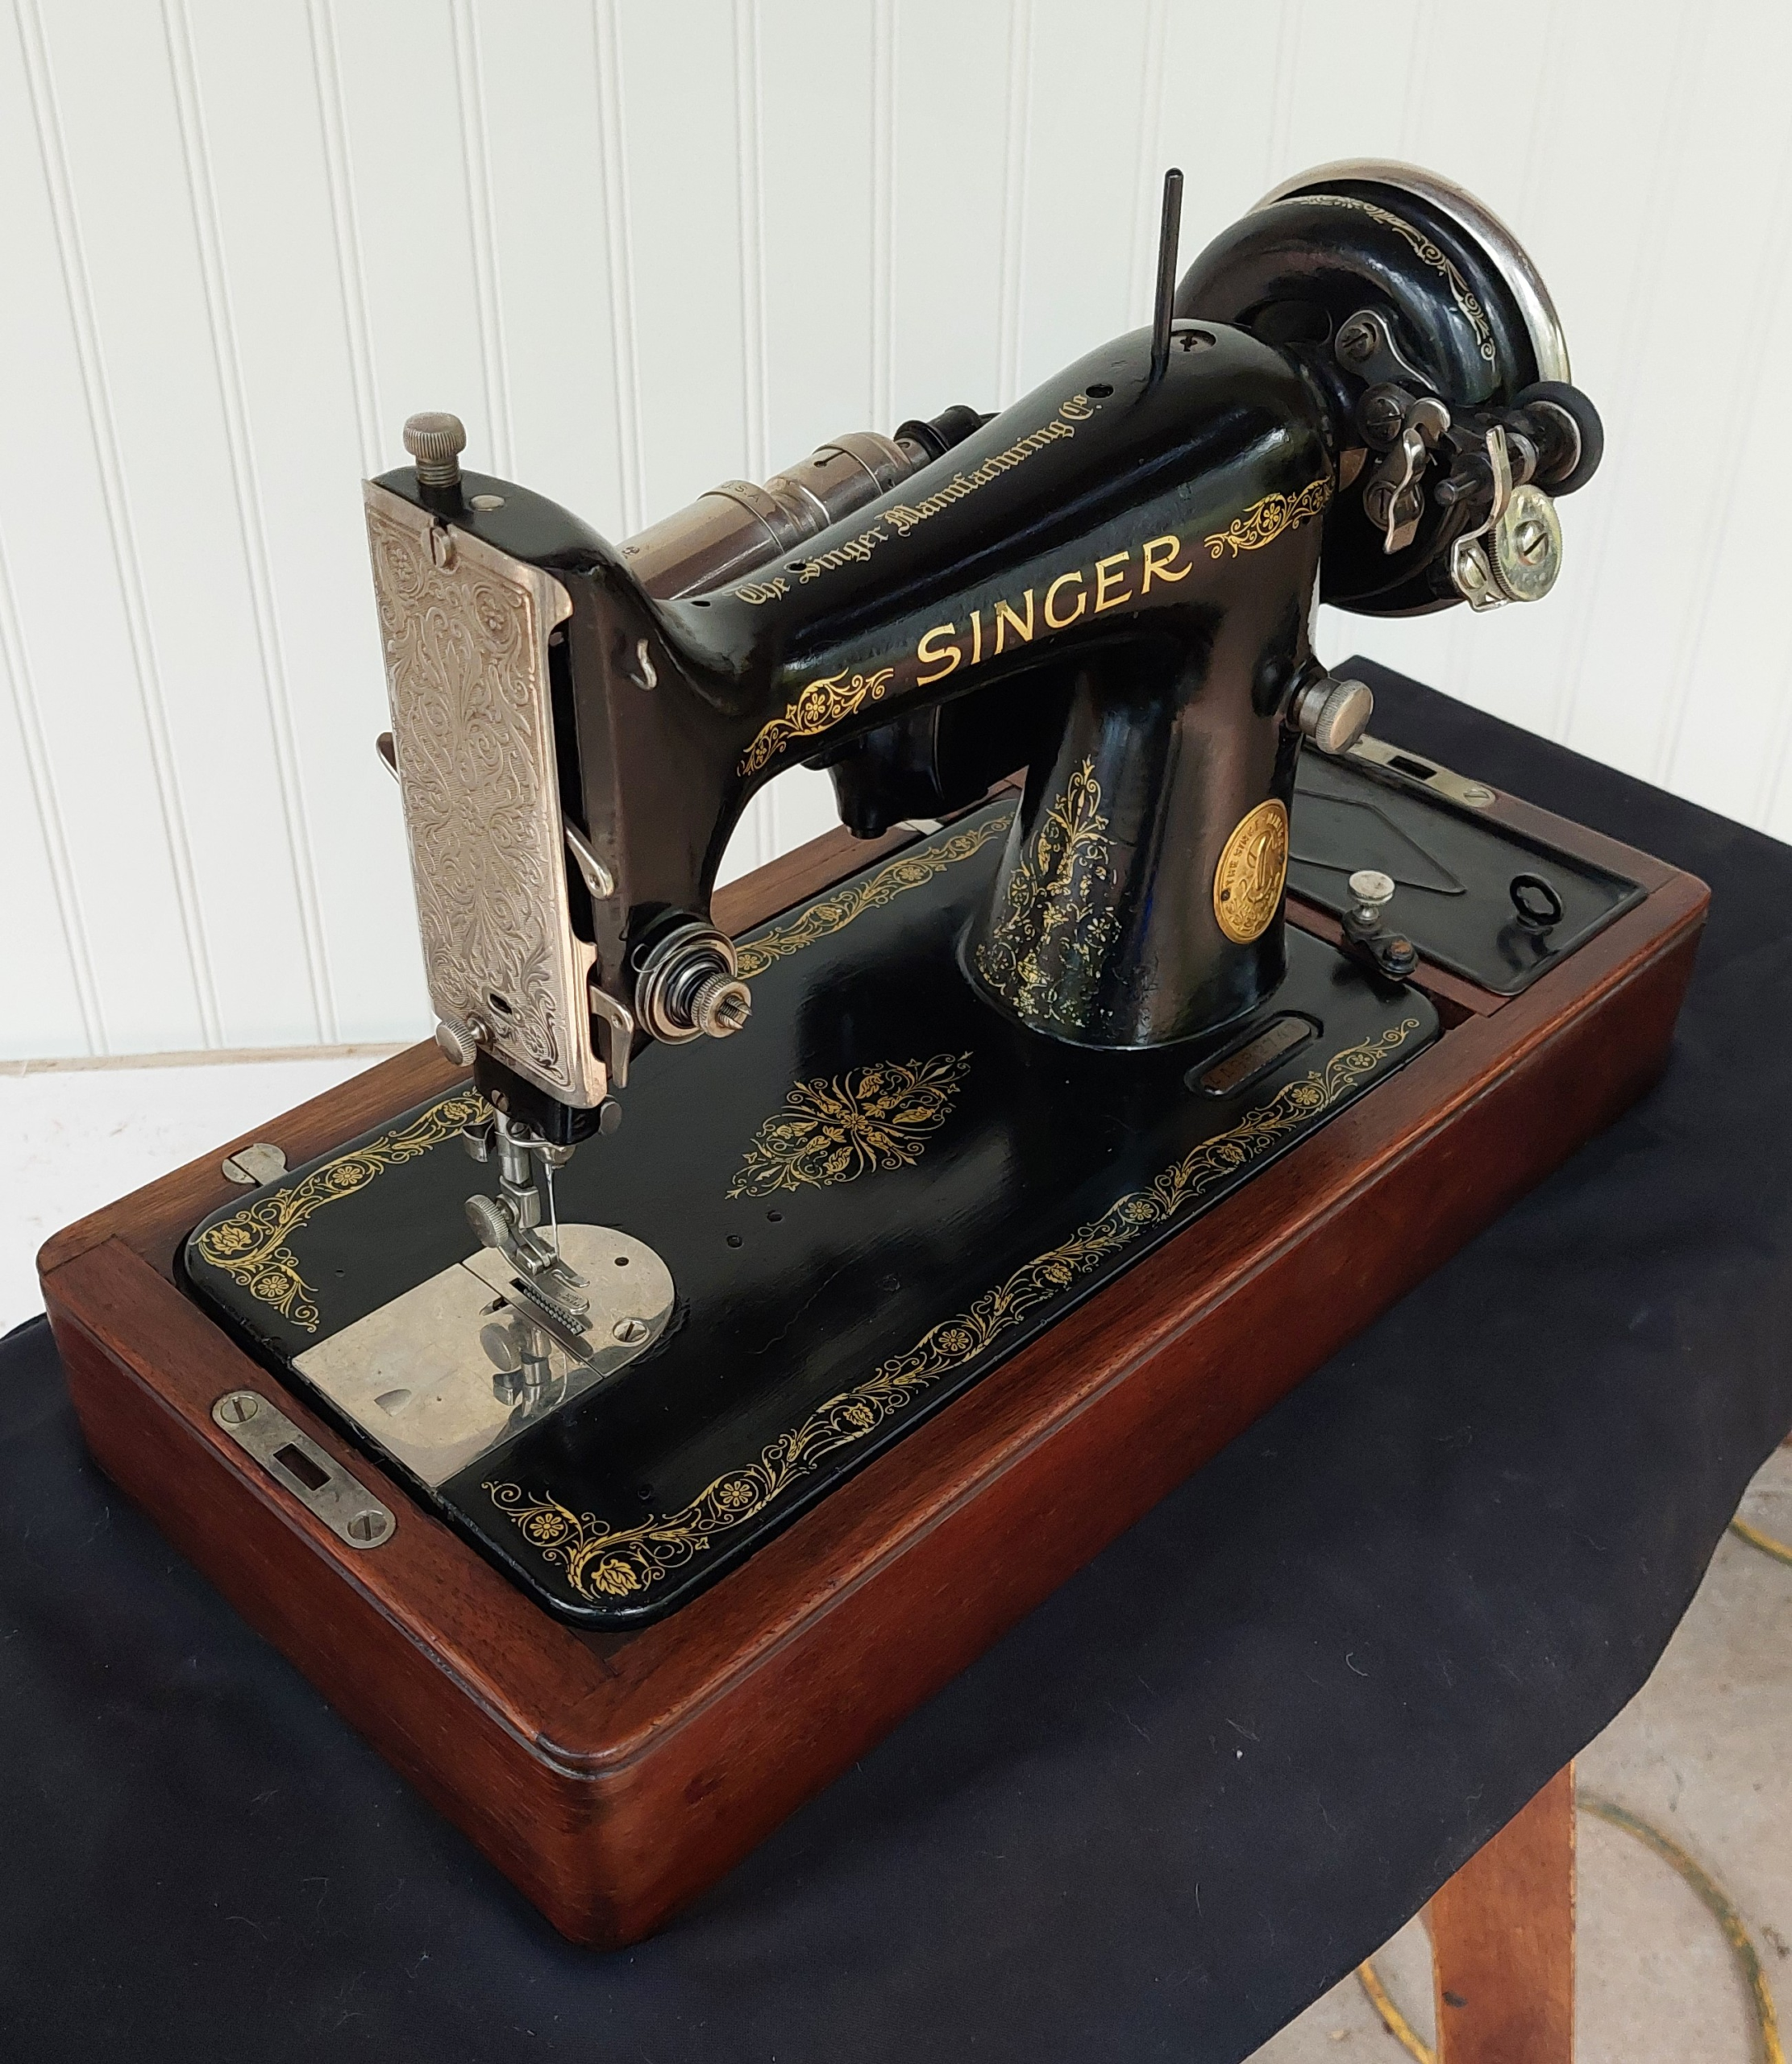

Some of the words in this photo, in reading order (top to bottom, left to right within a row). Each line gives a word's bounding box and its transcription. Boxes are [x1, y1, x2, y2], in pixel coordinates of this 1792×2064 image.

[722, 576, 791, 605] The
[784, 526, 889, 585] Singer
[874, 419, 1075, 537] Manufacturing
[917, 535, 1193, 687] SINGER
